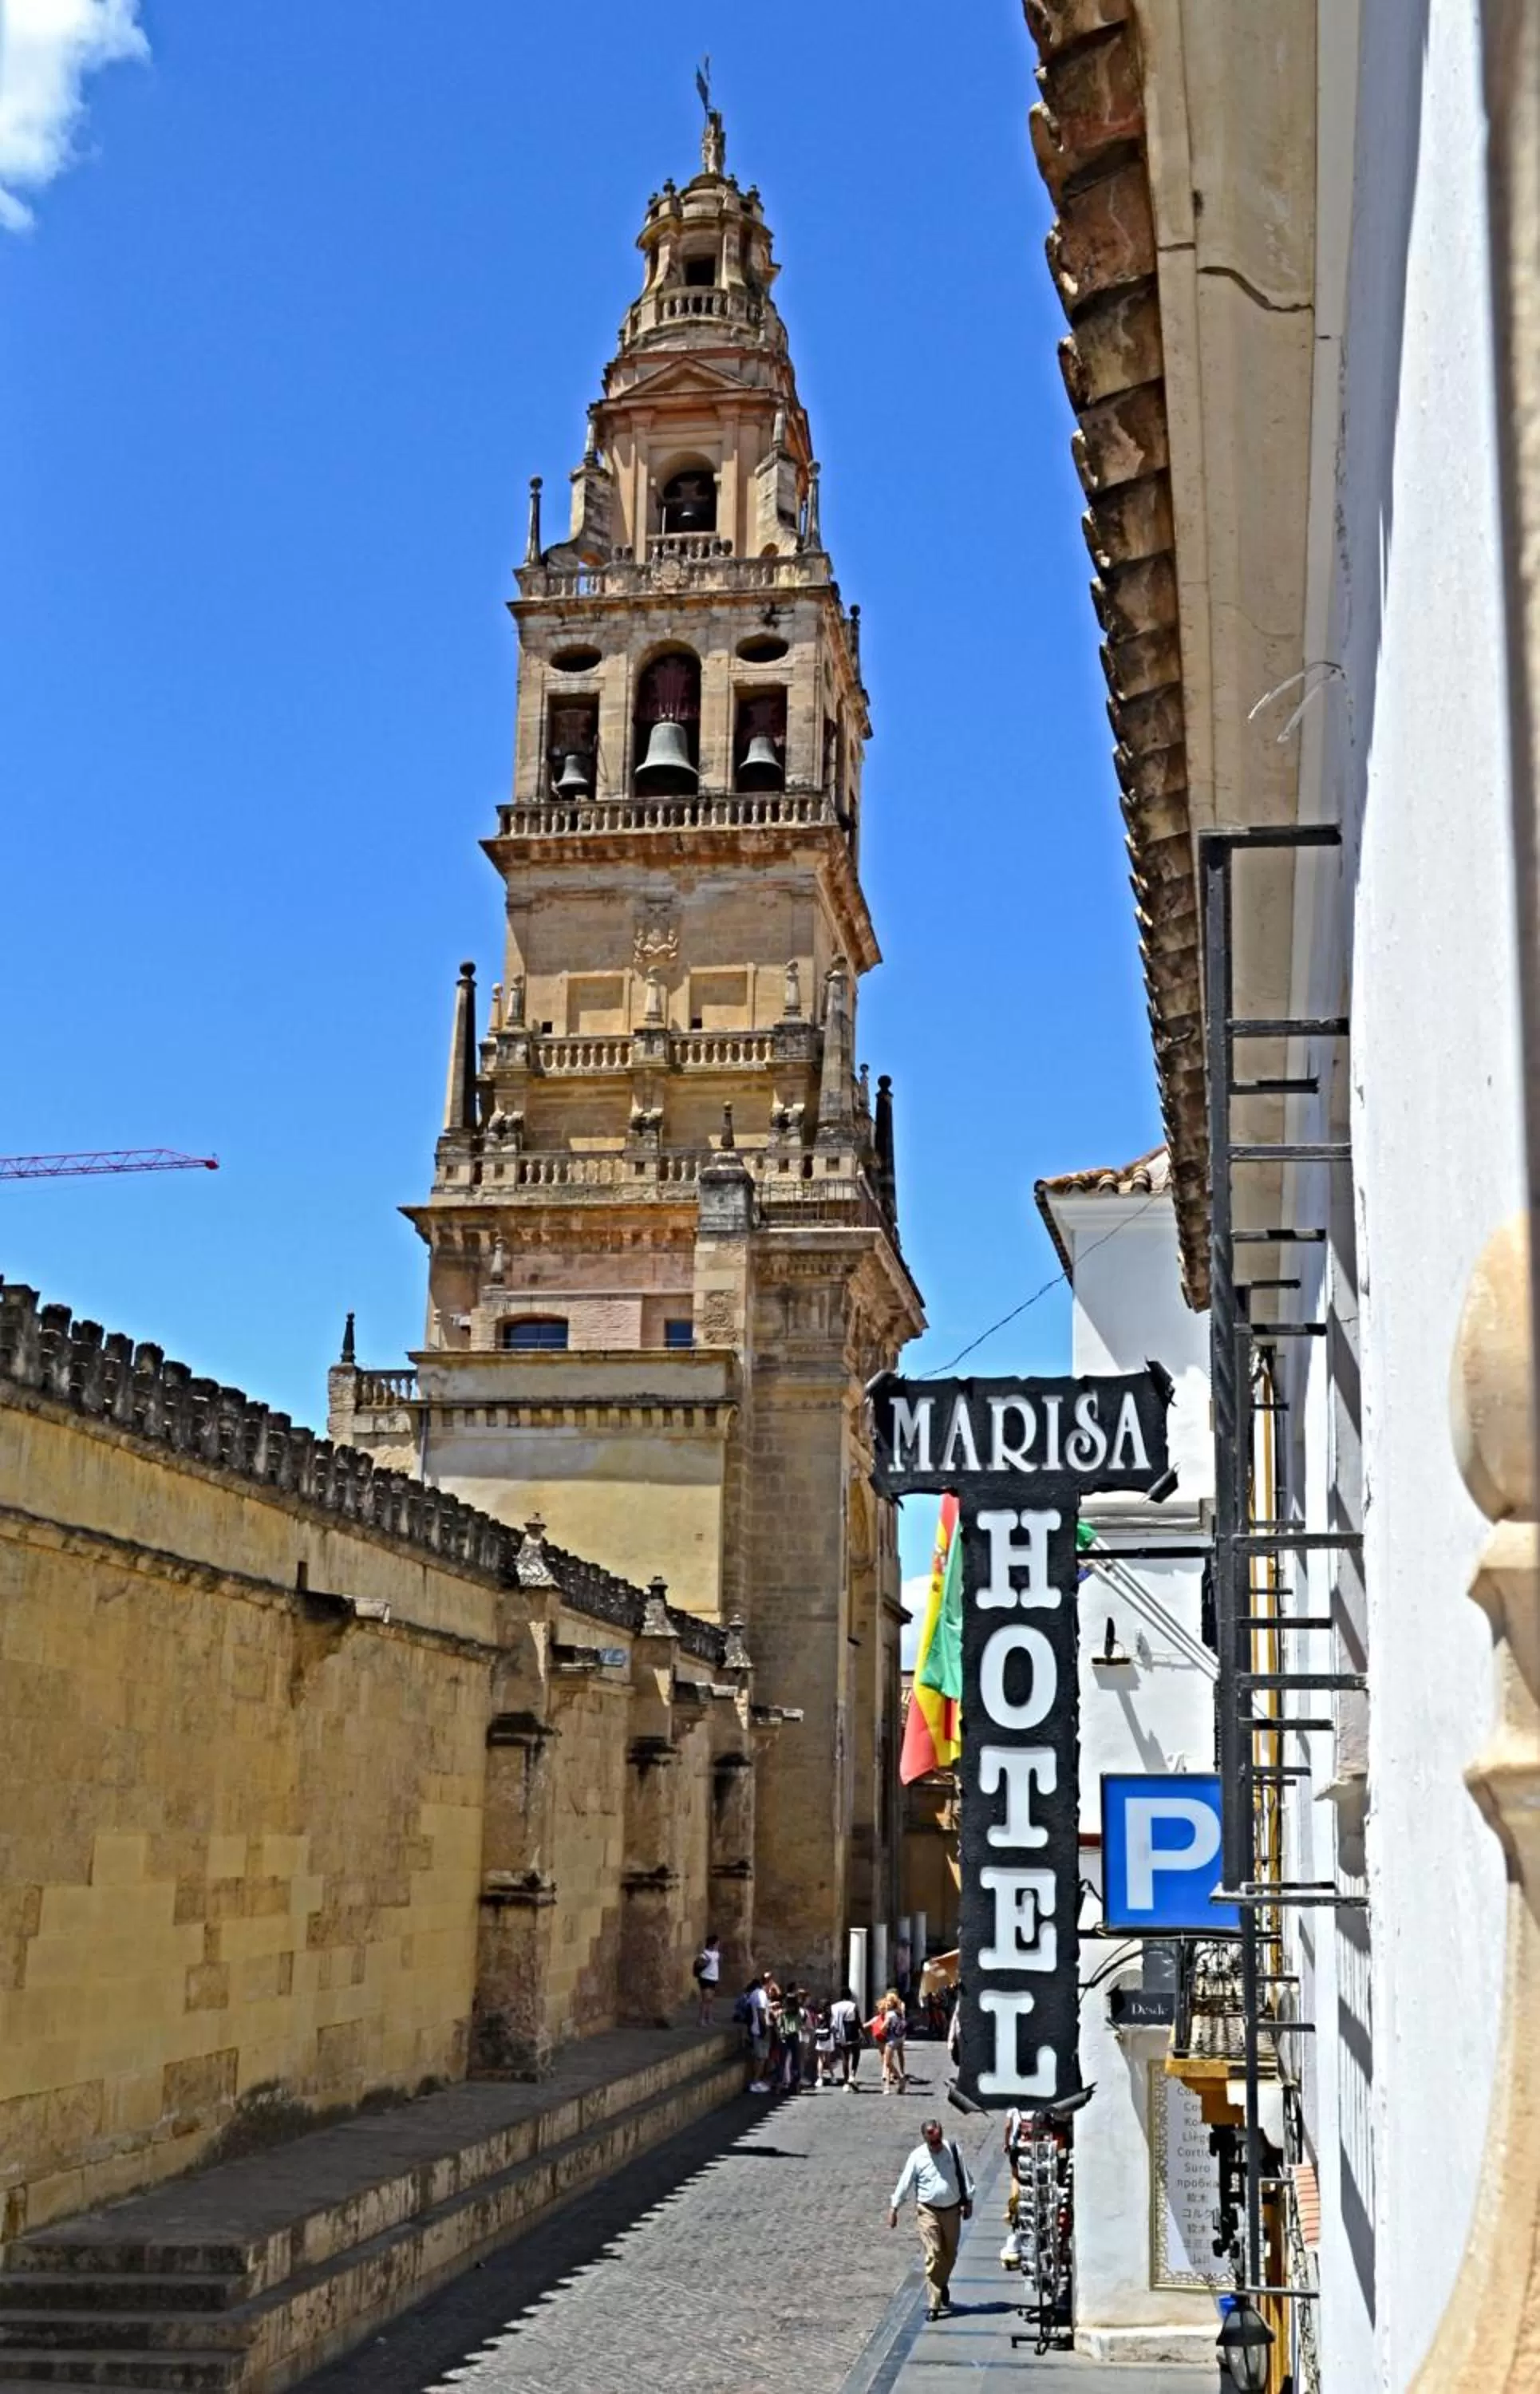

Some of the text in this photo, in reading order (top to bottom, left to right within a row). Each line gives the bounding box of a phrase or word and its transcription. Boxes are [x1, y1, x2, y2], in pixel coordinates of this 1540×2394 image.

[888, 1390, 1152, 1474] MARISA
[977, 1509, 1063, 2098] HOTEL
[1125, 1797, 1222, 1910] P
[1131, 2003, 1169, 2016] Desde
